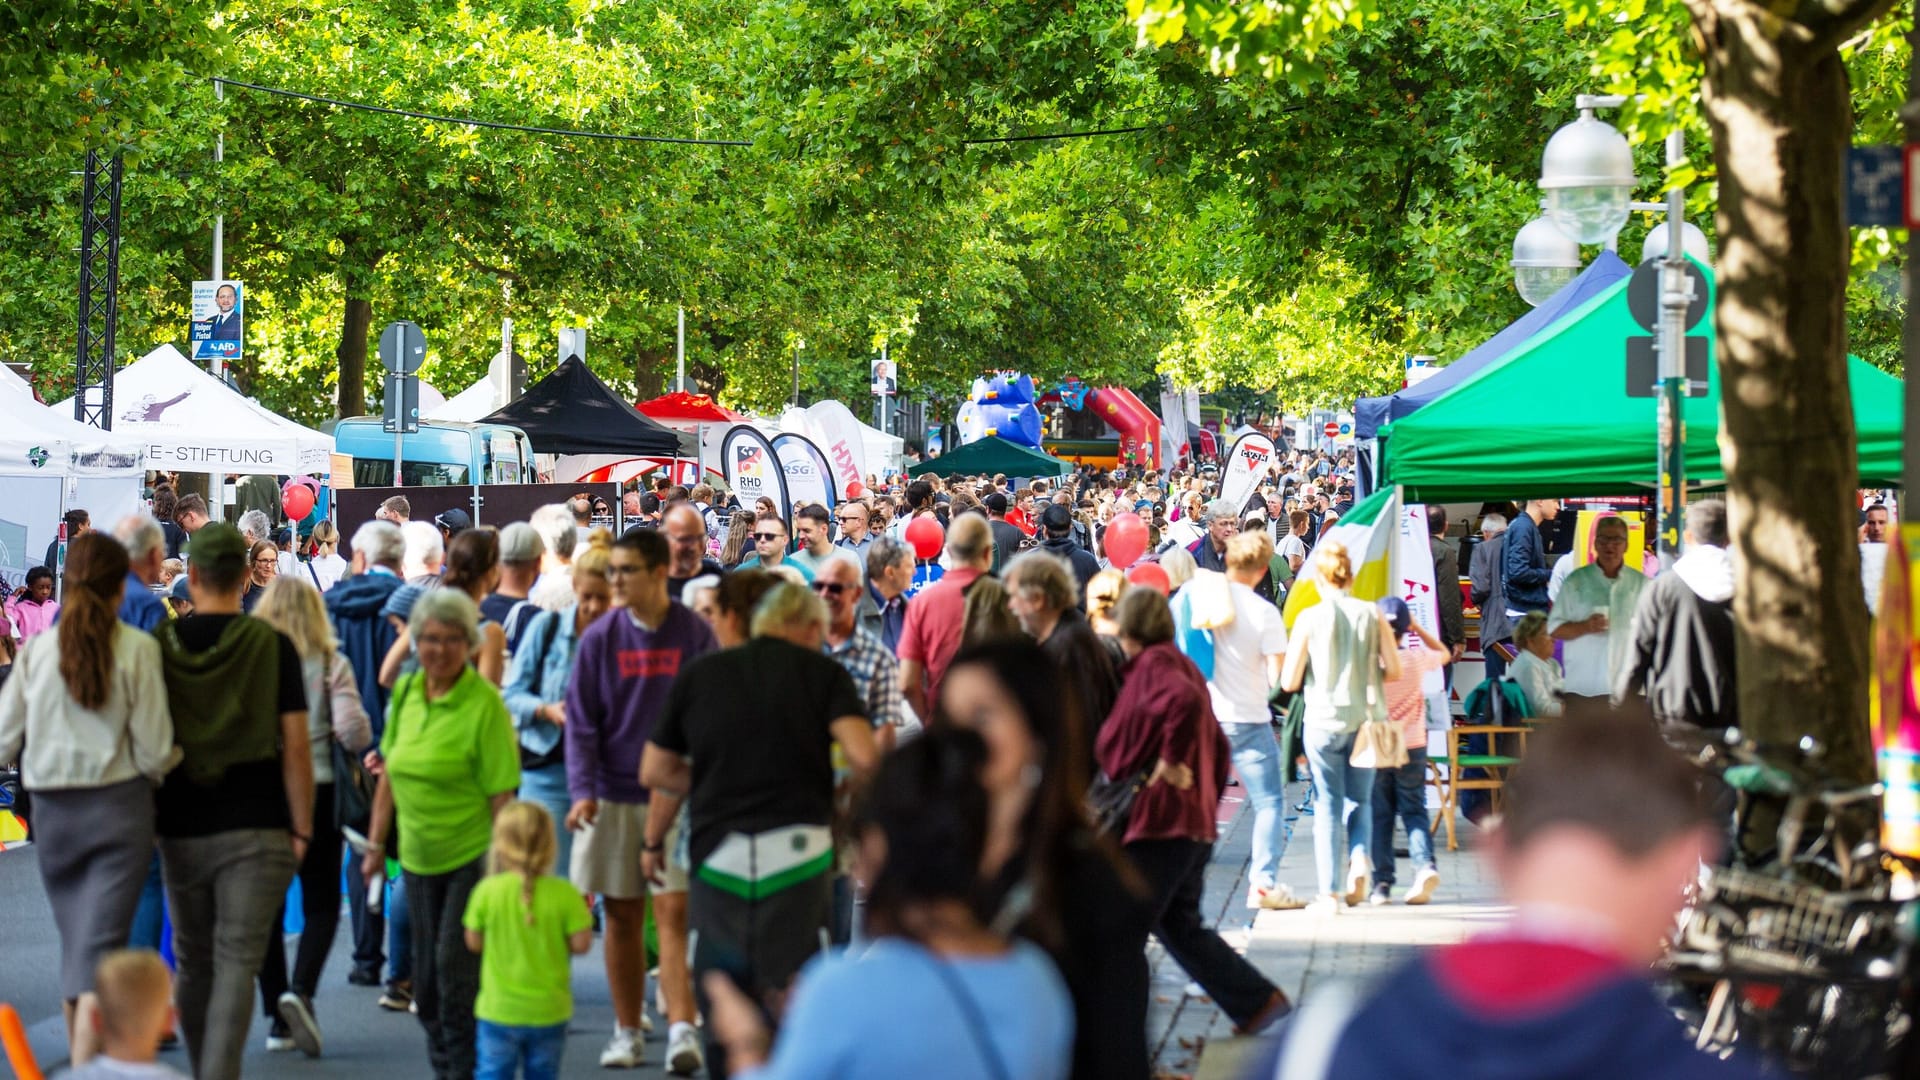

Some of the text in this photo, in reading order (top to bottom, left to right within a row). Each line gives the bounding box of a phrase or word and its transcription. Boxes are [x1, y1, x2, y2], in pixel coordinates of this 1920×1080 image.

[194, 323, 212, 333] Holger
[195, 332, 211, 340] Pistol
[145, 444, 273, 464] E-STIFTUNG
[740, 476, 761, 487] RHD
